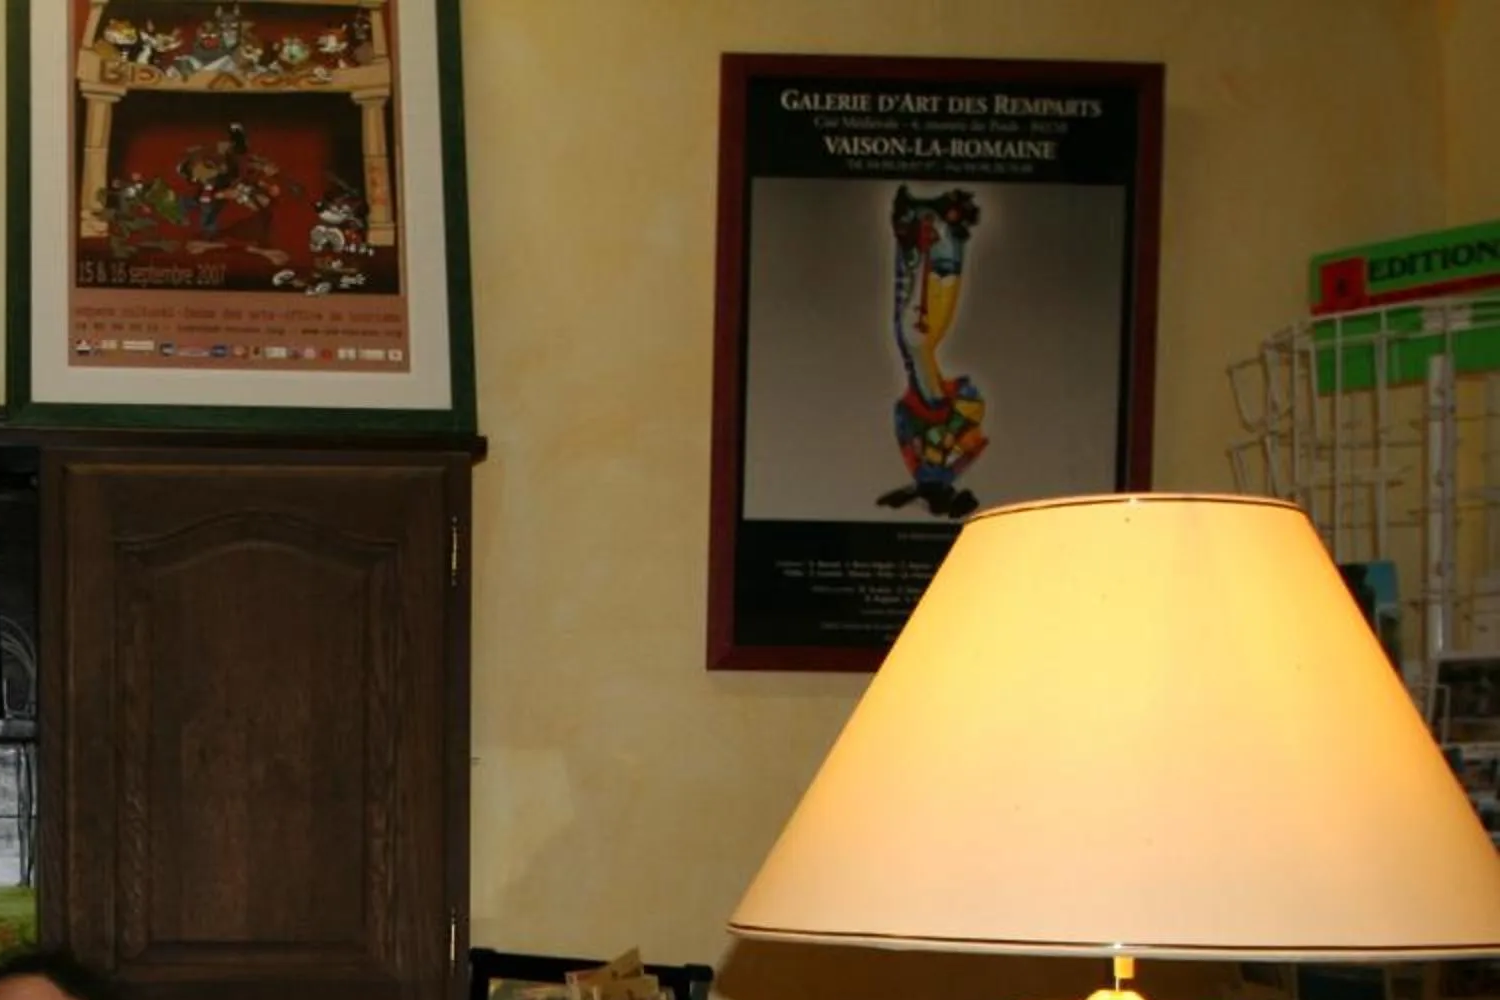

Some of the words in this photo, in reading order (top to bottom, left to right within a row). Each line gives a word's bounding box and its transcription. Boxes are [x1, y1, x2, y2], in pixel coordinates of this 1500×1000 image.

[780, 89, 872, 113] GALERIE
[878, 92, 940, 114] D'ART
[948, 95, 988, 115] DES
[994, 95, 1103, 119] REMPARTS
[822, 135, 1057, 161] VAISON-LA-ROMAINE
